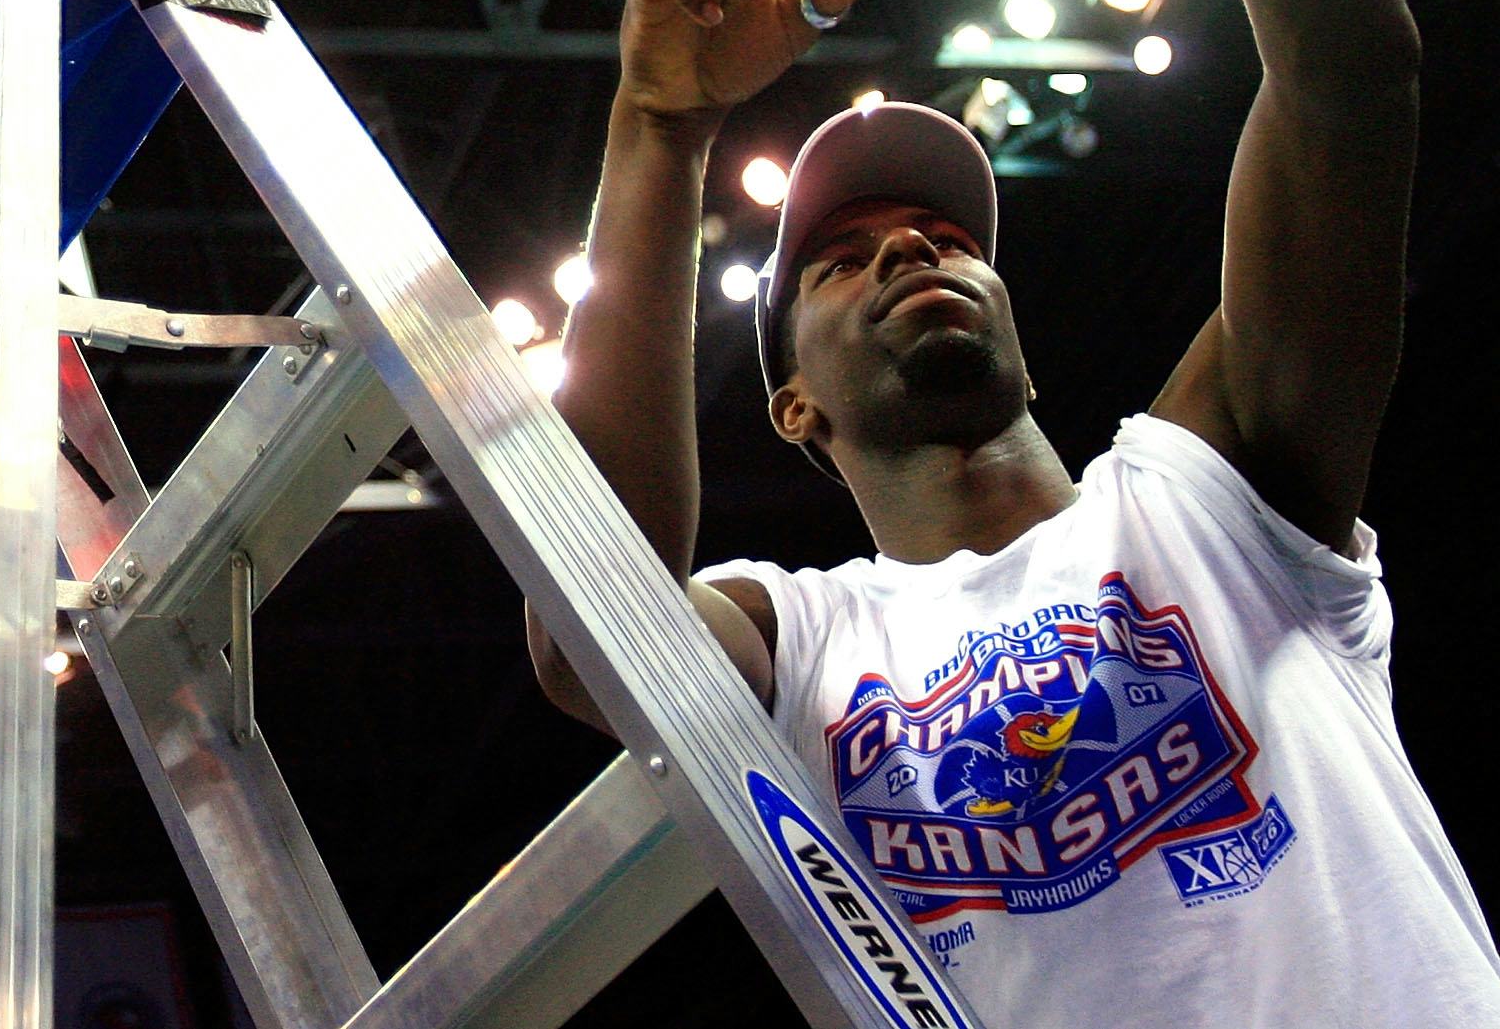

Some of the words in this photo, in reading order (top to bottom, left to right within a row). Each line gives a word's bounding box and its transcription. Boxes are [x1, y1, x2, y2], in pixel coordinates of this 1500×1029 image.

[1033, 603, 1098, 627] BAC
[972, 635, 1027, 669] BIG
[1032, 632, 1059, 655] 12
[848, 613, 1184, 776] CHAMPINS
[1128, 684, 1159, 704] 07
[889, 765, 917, 794] 20
[1003, 767, 1039, 788] KU
[867, 720, 1201, 874] KANSAS
[1007, 859, 1113, 908] JAYHAWKS
